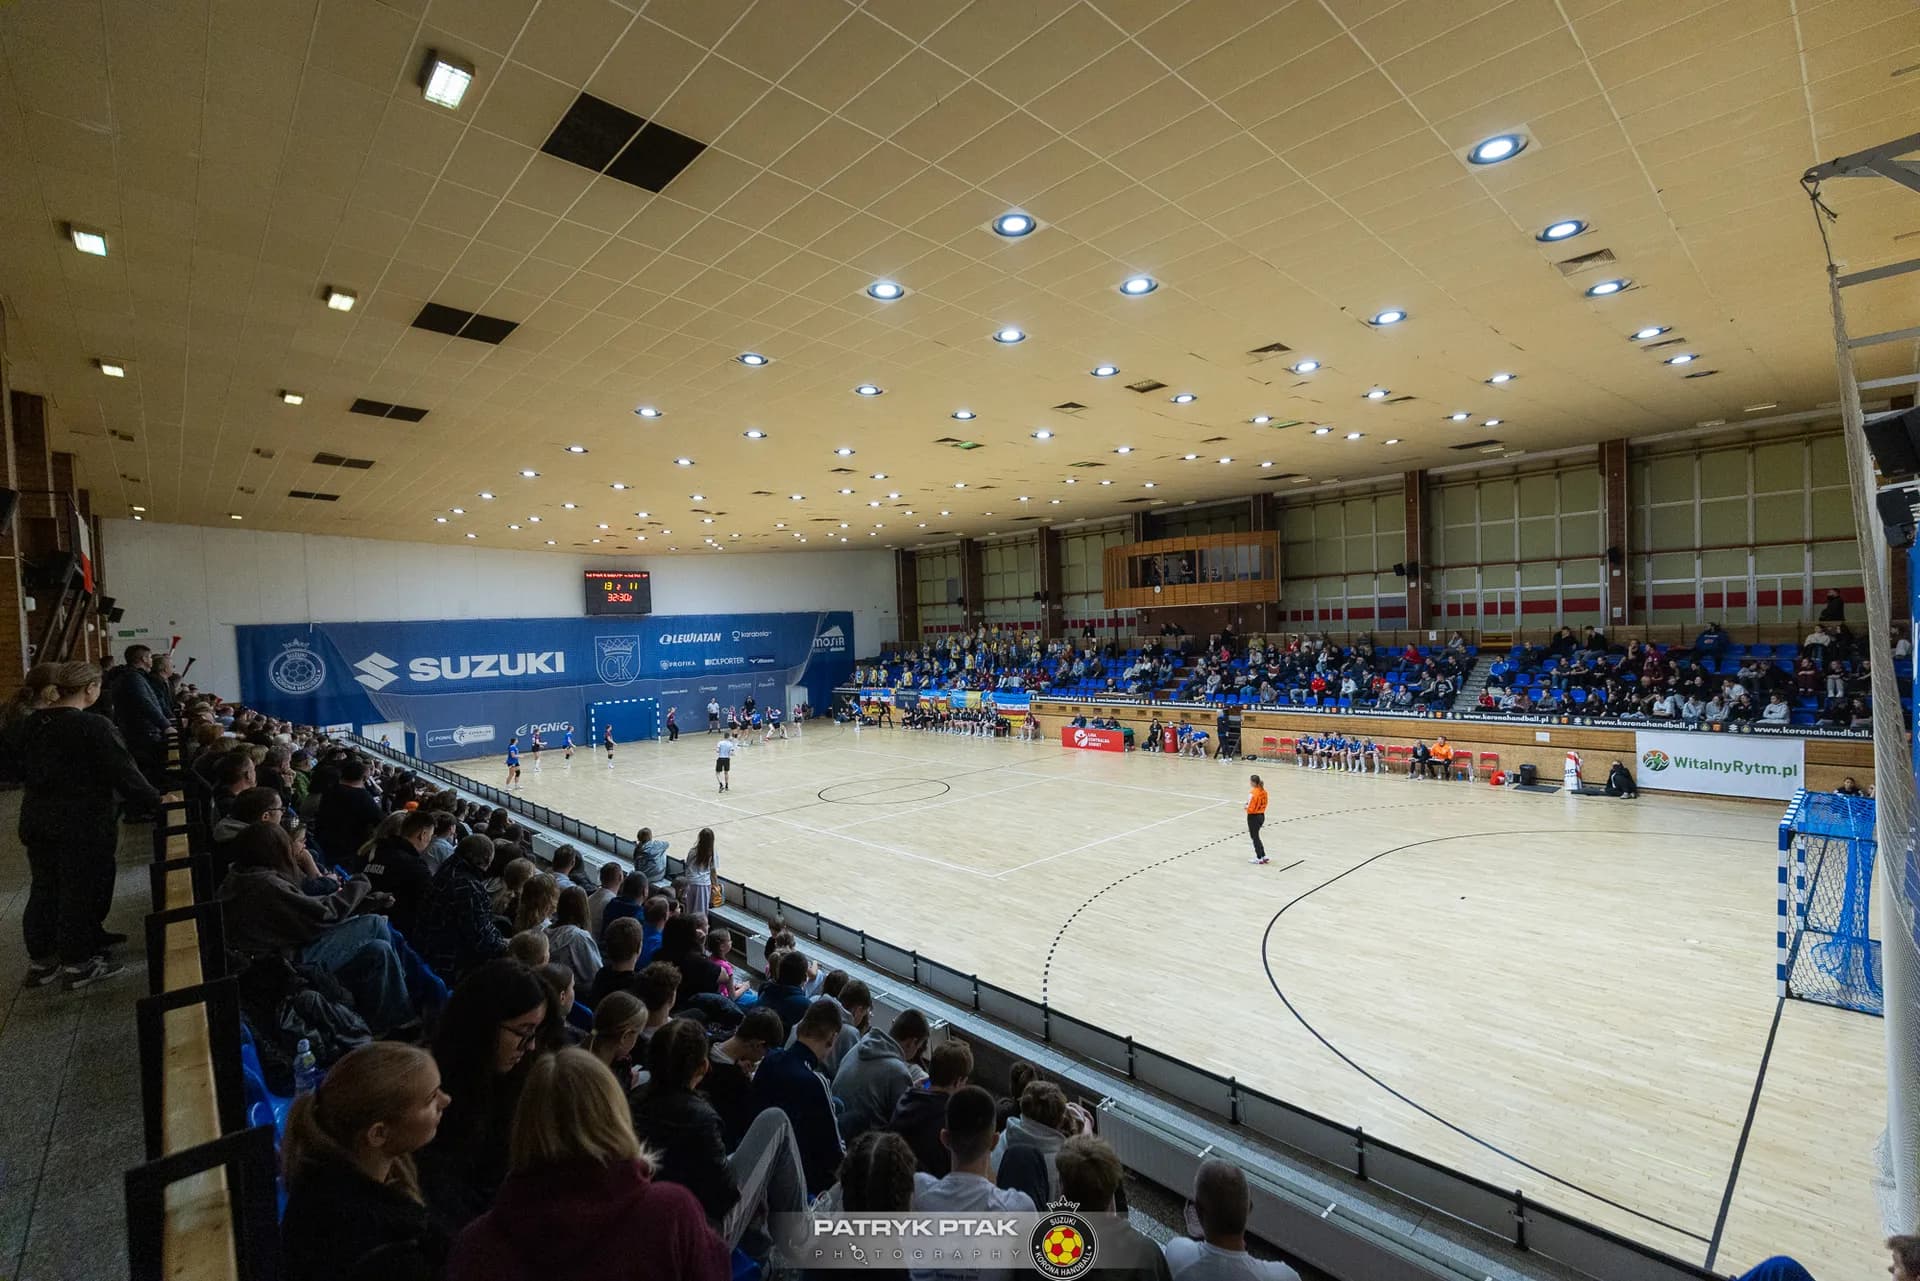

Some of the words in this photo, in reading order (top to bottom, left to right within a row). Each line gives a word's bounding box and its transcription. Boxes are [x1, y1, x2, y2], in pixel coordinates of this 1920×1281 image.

[672, 632, 721, 644] LEWIATAN
[408, 651, 565, 682] SUZUKI
[530, 721, 569, 734] PGNiG
[1593, 719, 1698, 731] www.koronahandball.pl
[1753, 726, 1873, 738] www.koronahandball.
[1673, 756, 1798, 778] WitalnyRytm.pl
